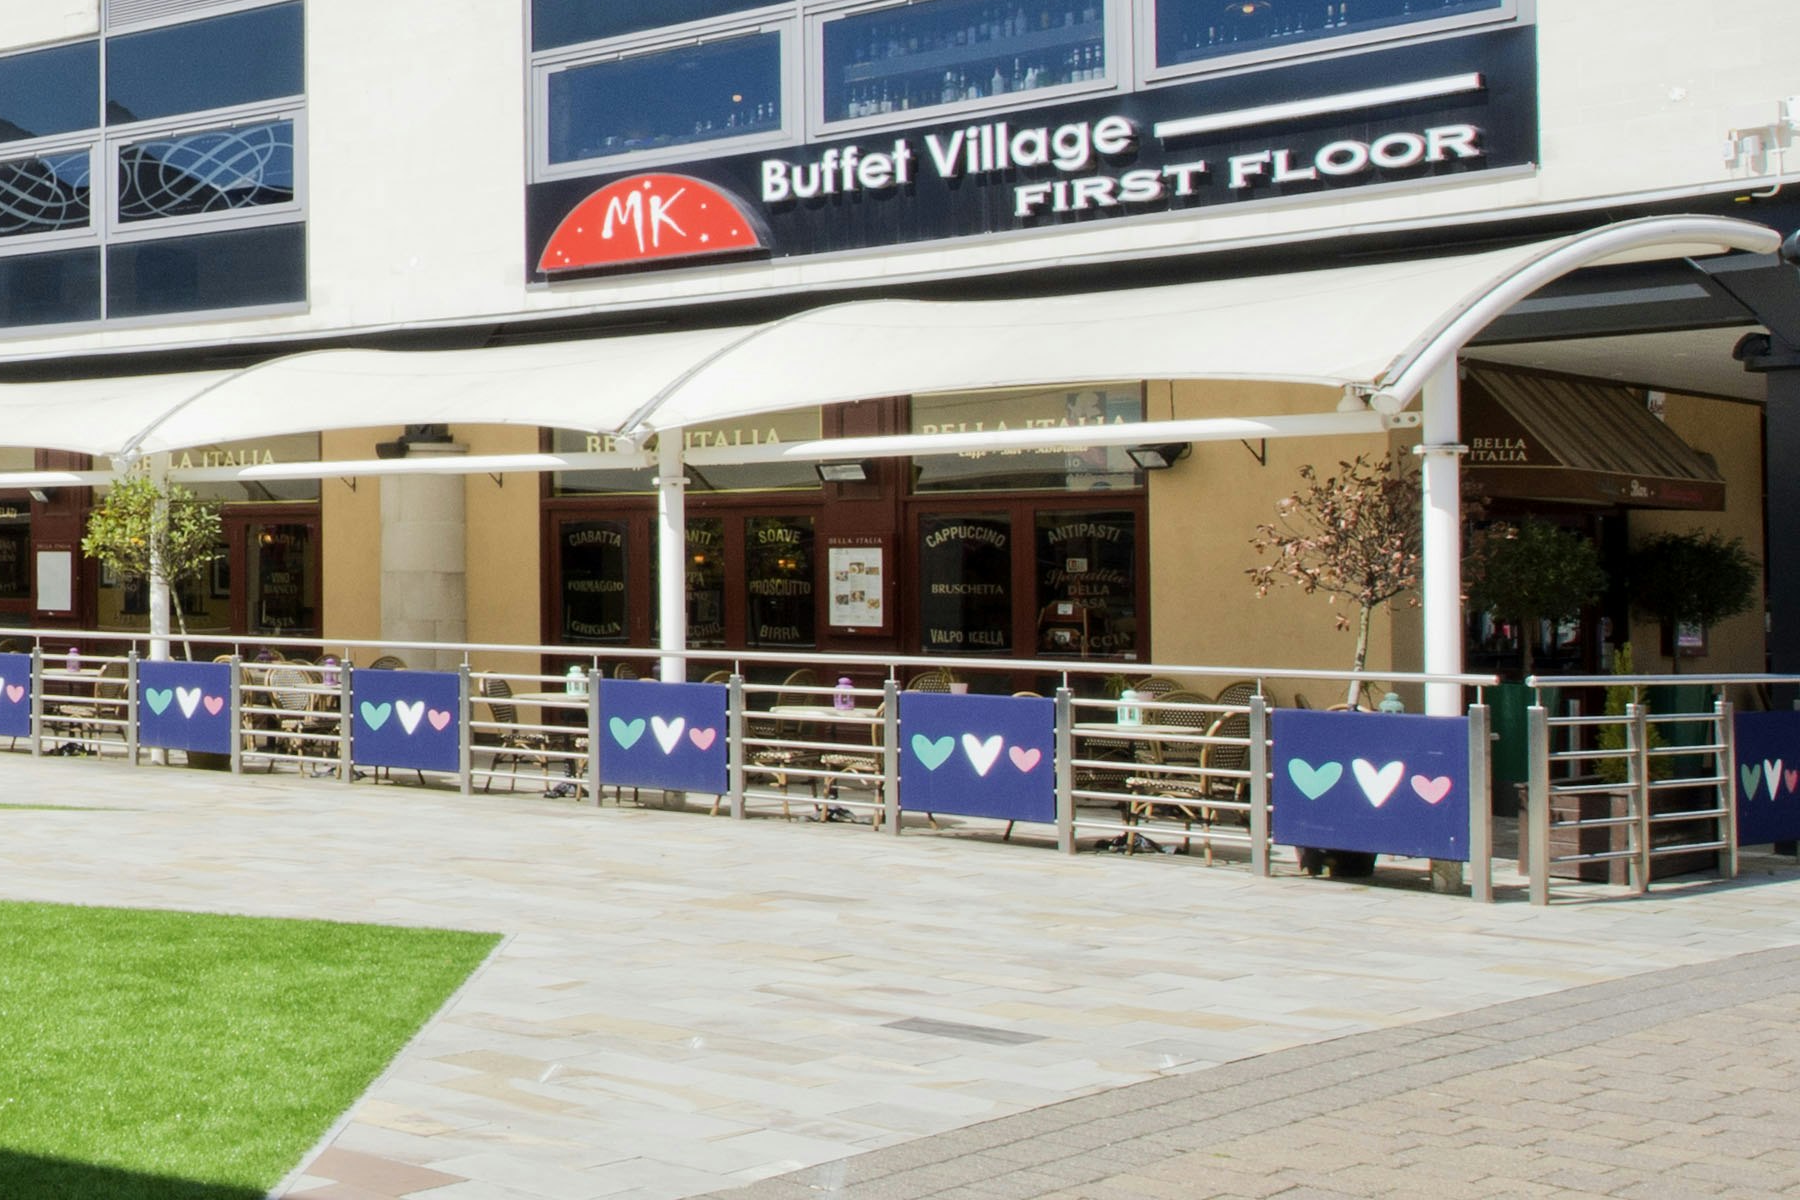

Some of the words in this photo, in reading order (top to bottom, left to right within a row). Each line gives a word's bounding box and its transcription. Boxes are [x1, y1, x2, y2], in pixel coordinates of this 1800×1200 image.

[762, 139, 911, 202] Buffet
[925, 116, 1136, 179] Village
[1013, 159, 1205, 217] FIRST
[1228, 125, 1481, 188] FLOOR
[602, 189, 687, 253] MK
[685, 428, 781, 449] ITALIA
[1473, 438, 1527, 449] BELLA
[203, 449, 274, 468] ITALIA
[1470, 450, 1528, 461] ITALIA
[569, 530, 621, 547] CIABATTA
[758, 529, 800, 544] SOAVE
[926, 525, 1006, 548] CAPPUCCINO
[1047, 523, 1121, 544] ANTIPASTI
[568, 580, 624, 592] FORMAGGIO
[749, 579, 811, 595] PROSCIUTTO
[931, 583, 1004, 594] BRUSCHETTA
[571, 620, 620, 635] GRIGLIA
[760, 625, 800, 639] BIRRA
